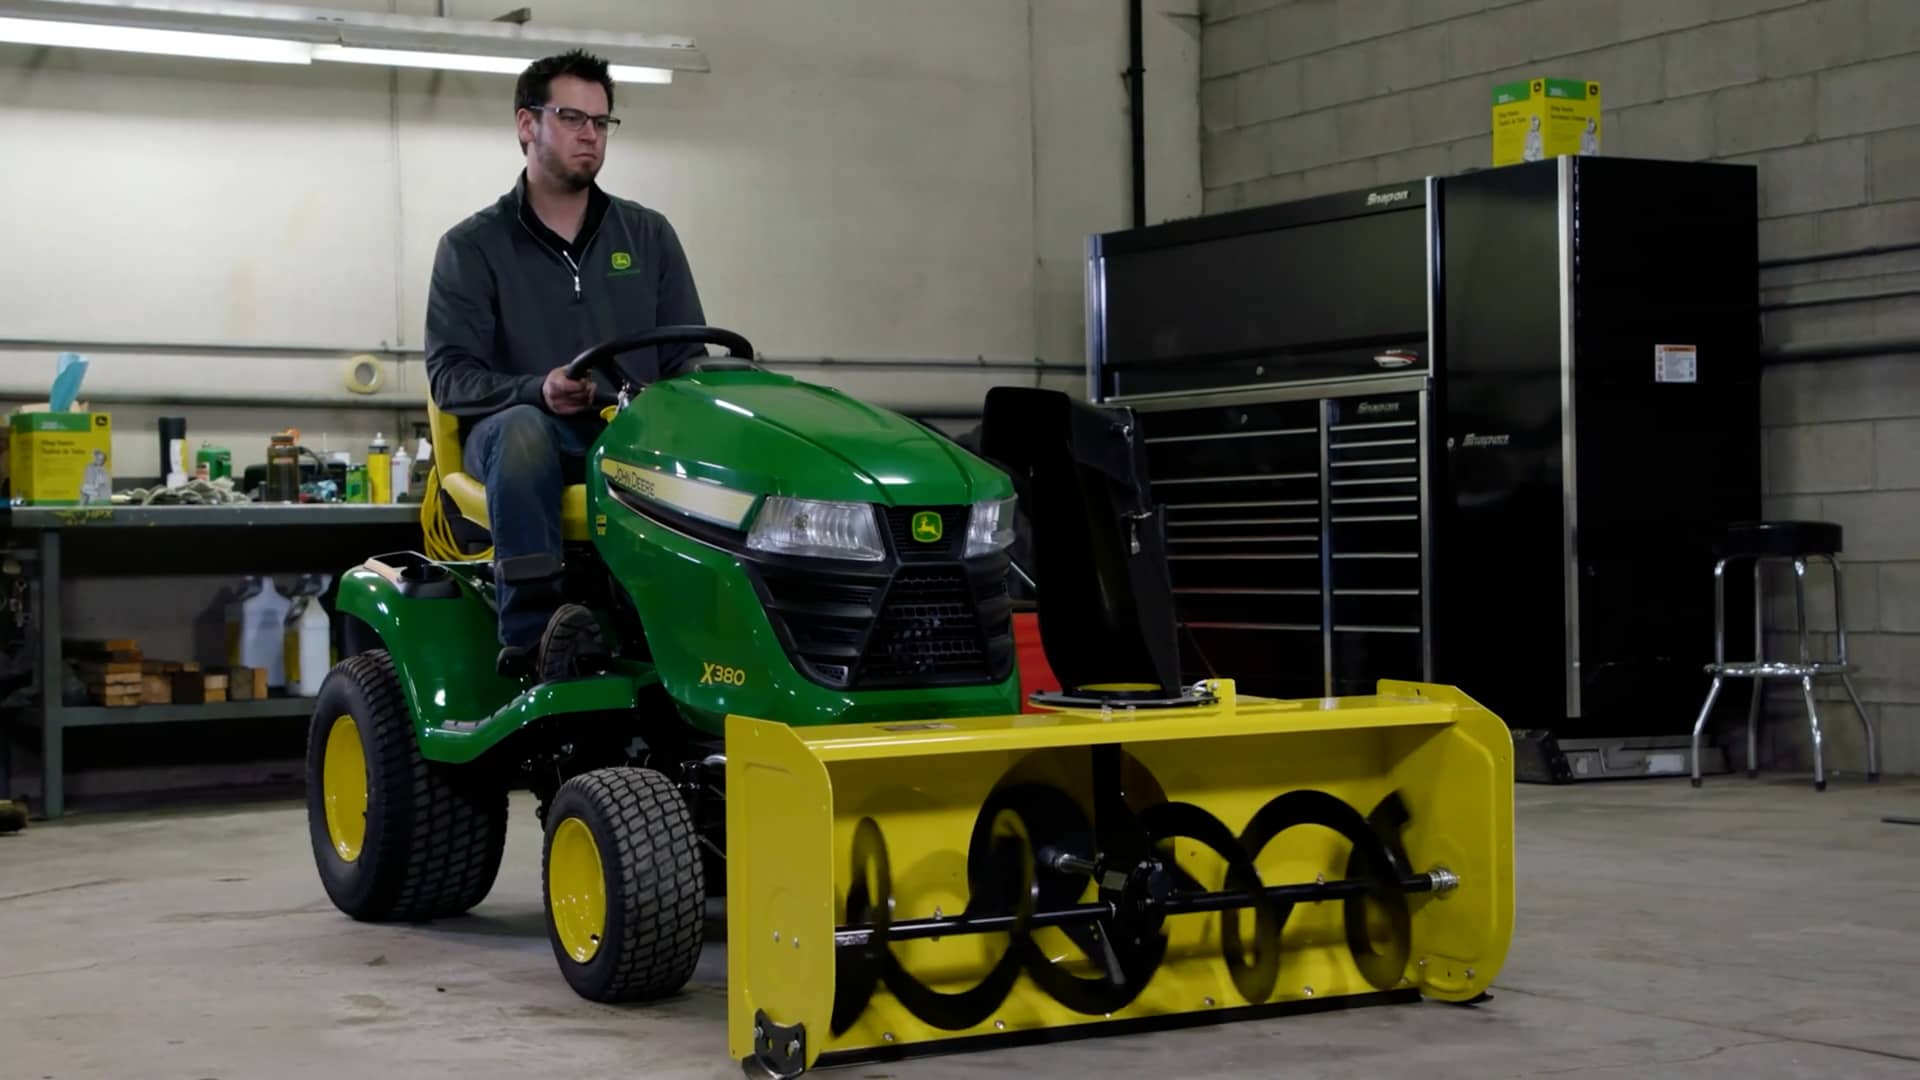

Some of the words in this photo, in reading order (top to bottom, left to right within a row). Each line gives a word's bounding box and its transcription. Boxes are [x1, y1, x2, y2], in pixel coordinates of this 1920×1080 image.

[614, 464, 632, 486] JOHN
[631, 471, 656, 496] DEERE
[700, 662, 745, 686] X380
